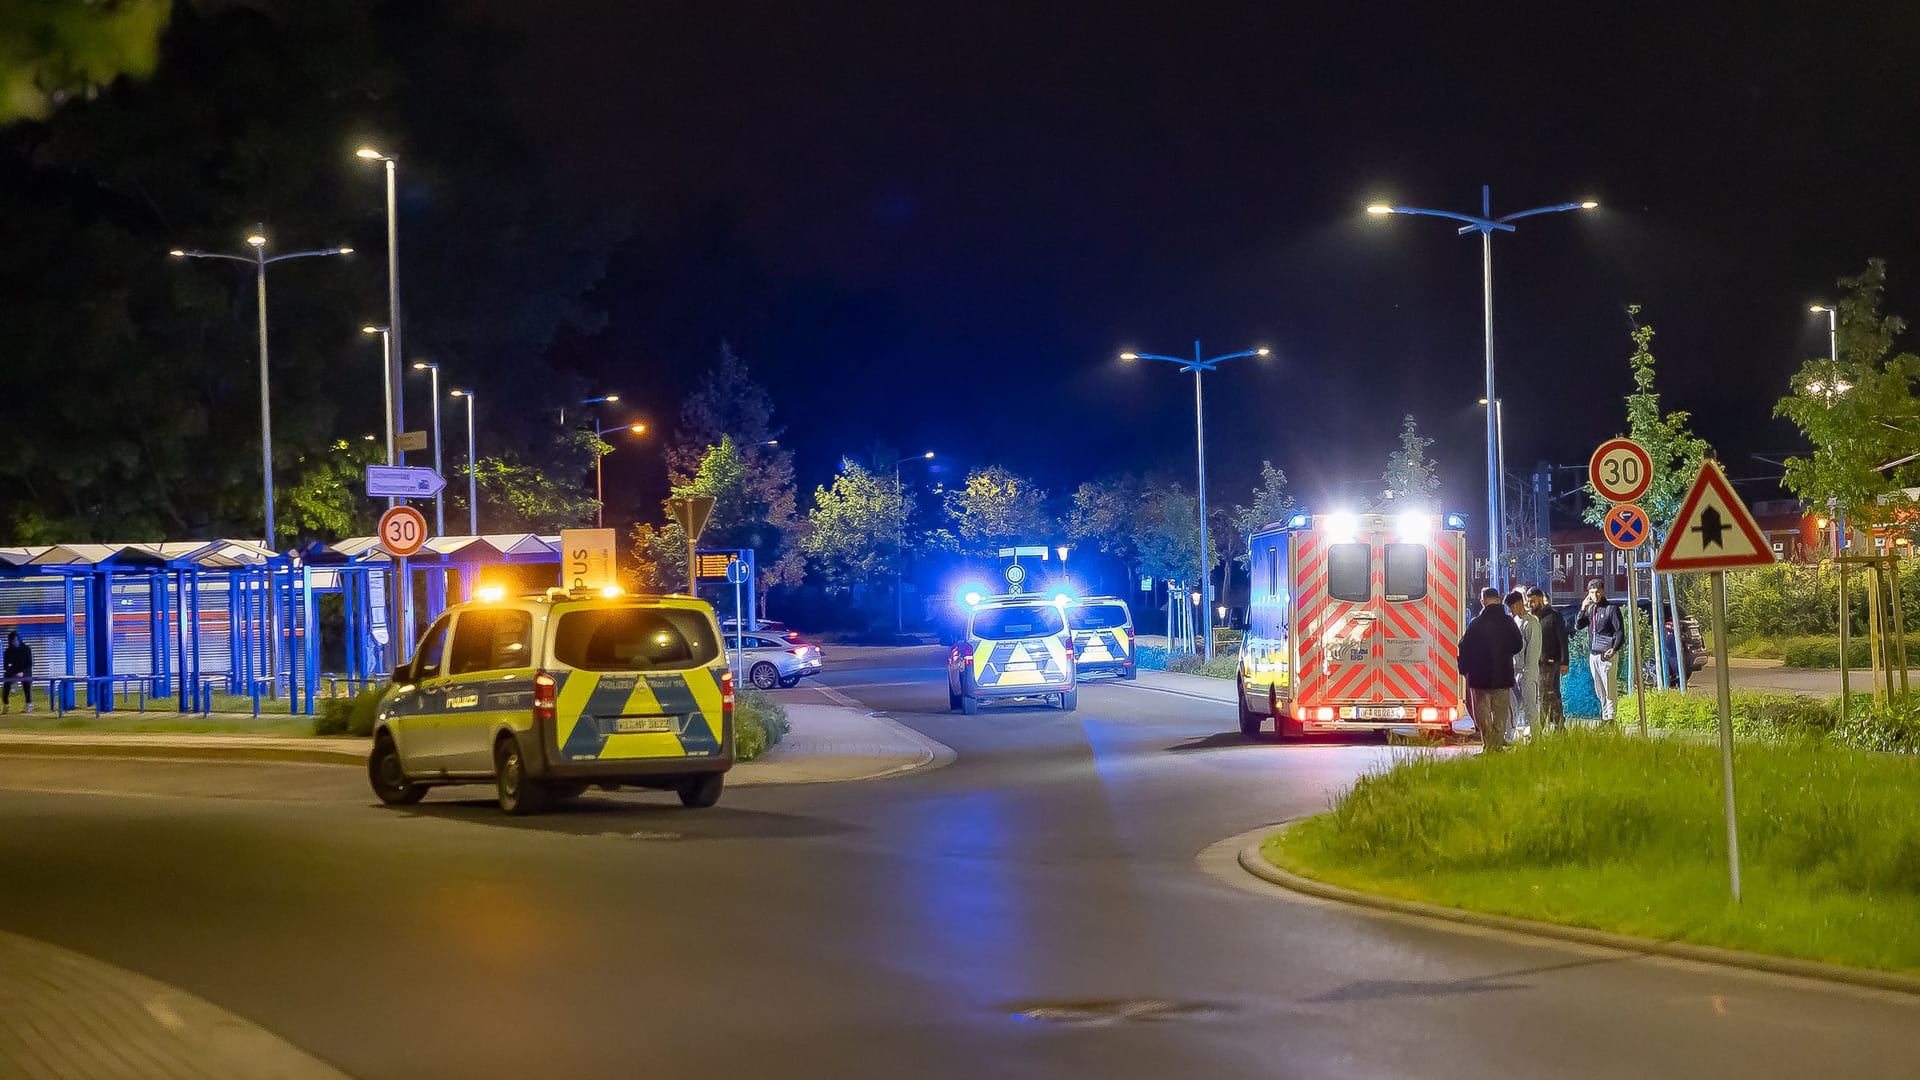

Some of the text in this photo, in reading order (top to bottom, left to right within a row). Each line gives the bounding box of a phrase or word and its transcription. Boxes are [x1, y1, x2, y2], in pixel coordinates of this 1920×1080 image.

[1604, 457, 1638, 485] 30
[390, 520, 415, 541] 30
[1010, 570, 1021, 579] 30
[600, 680, 634, 690] POLIZEI
